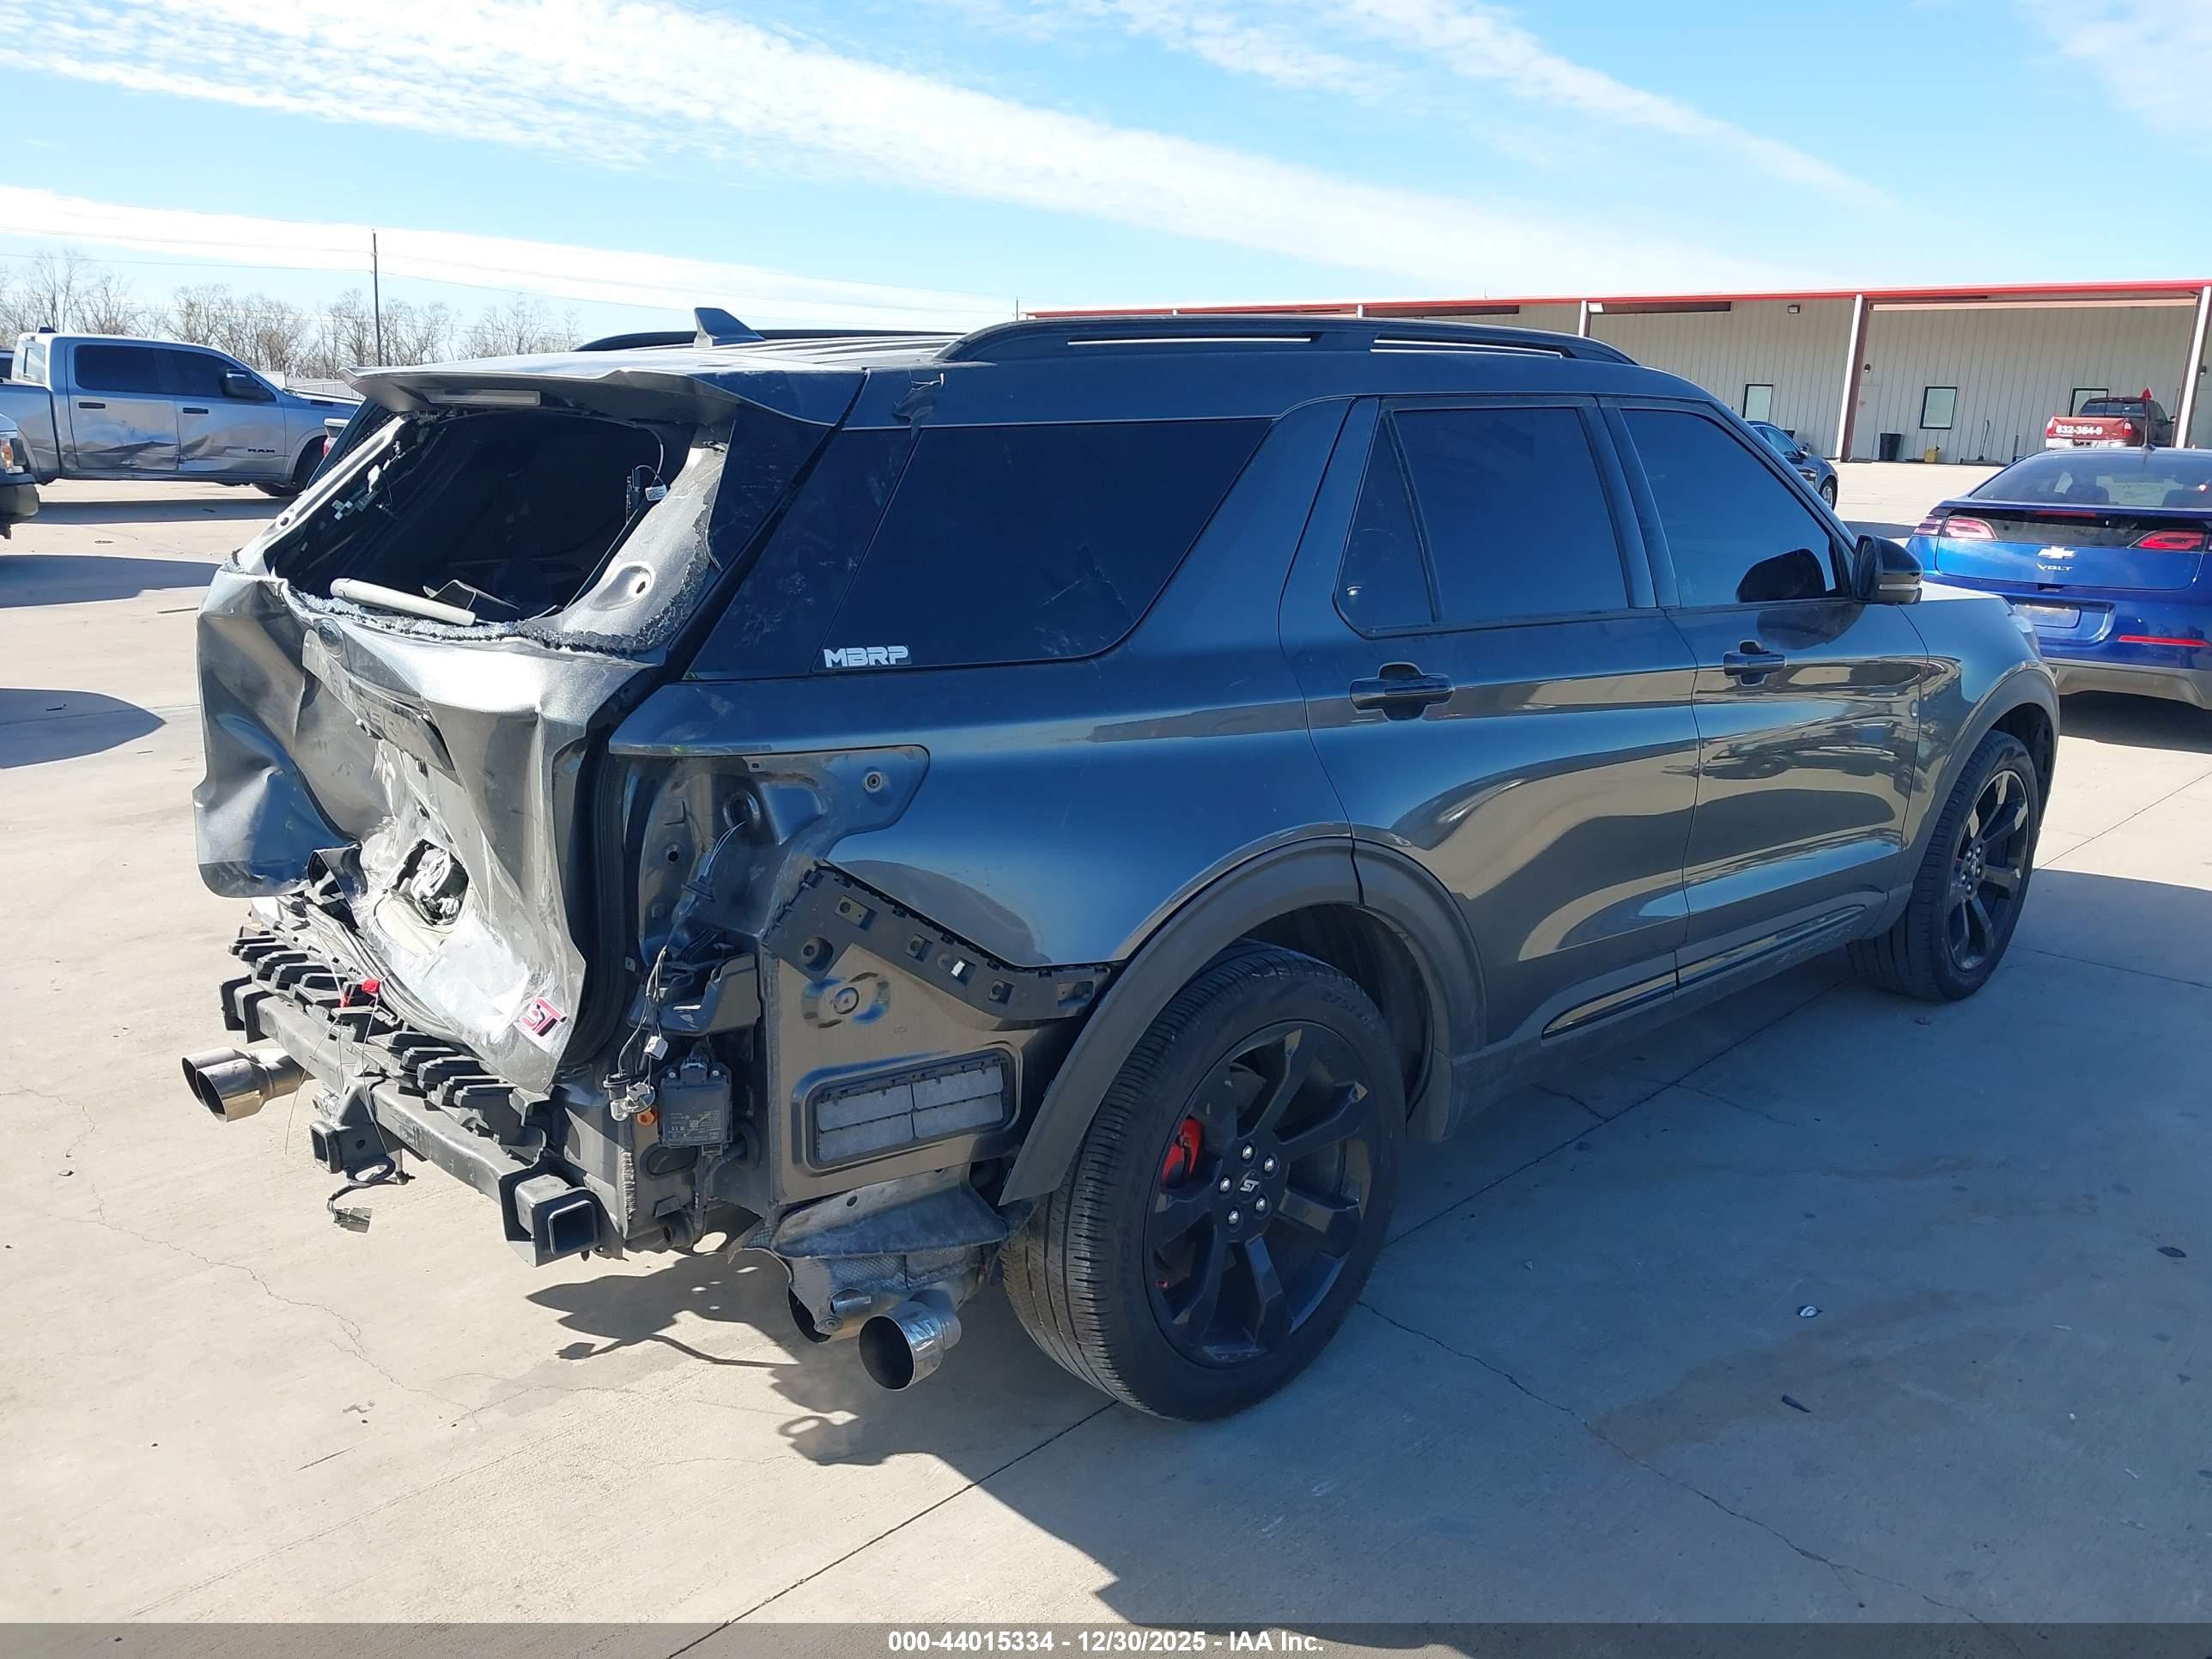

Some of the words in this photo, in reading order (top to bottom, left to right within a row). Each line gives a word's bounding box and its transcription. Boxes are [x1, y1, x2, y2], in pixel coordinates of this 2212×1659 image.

[2037, 562, 2074, 571] VOLT
[823, 646, 908, 667] MBRP
[1239, 1178, 1260, 1193] ST
